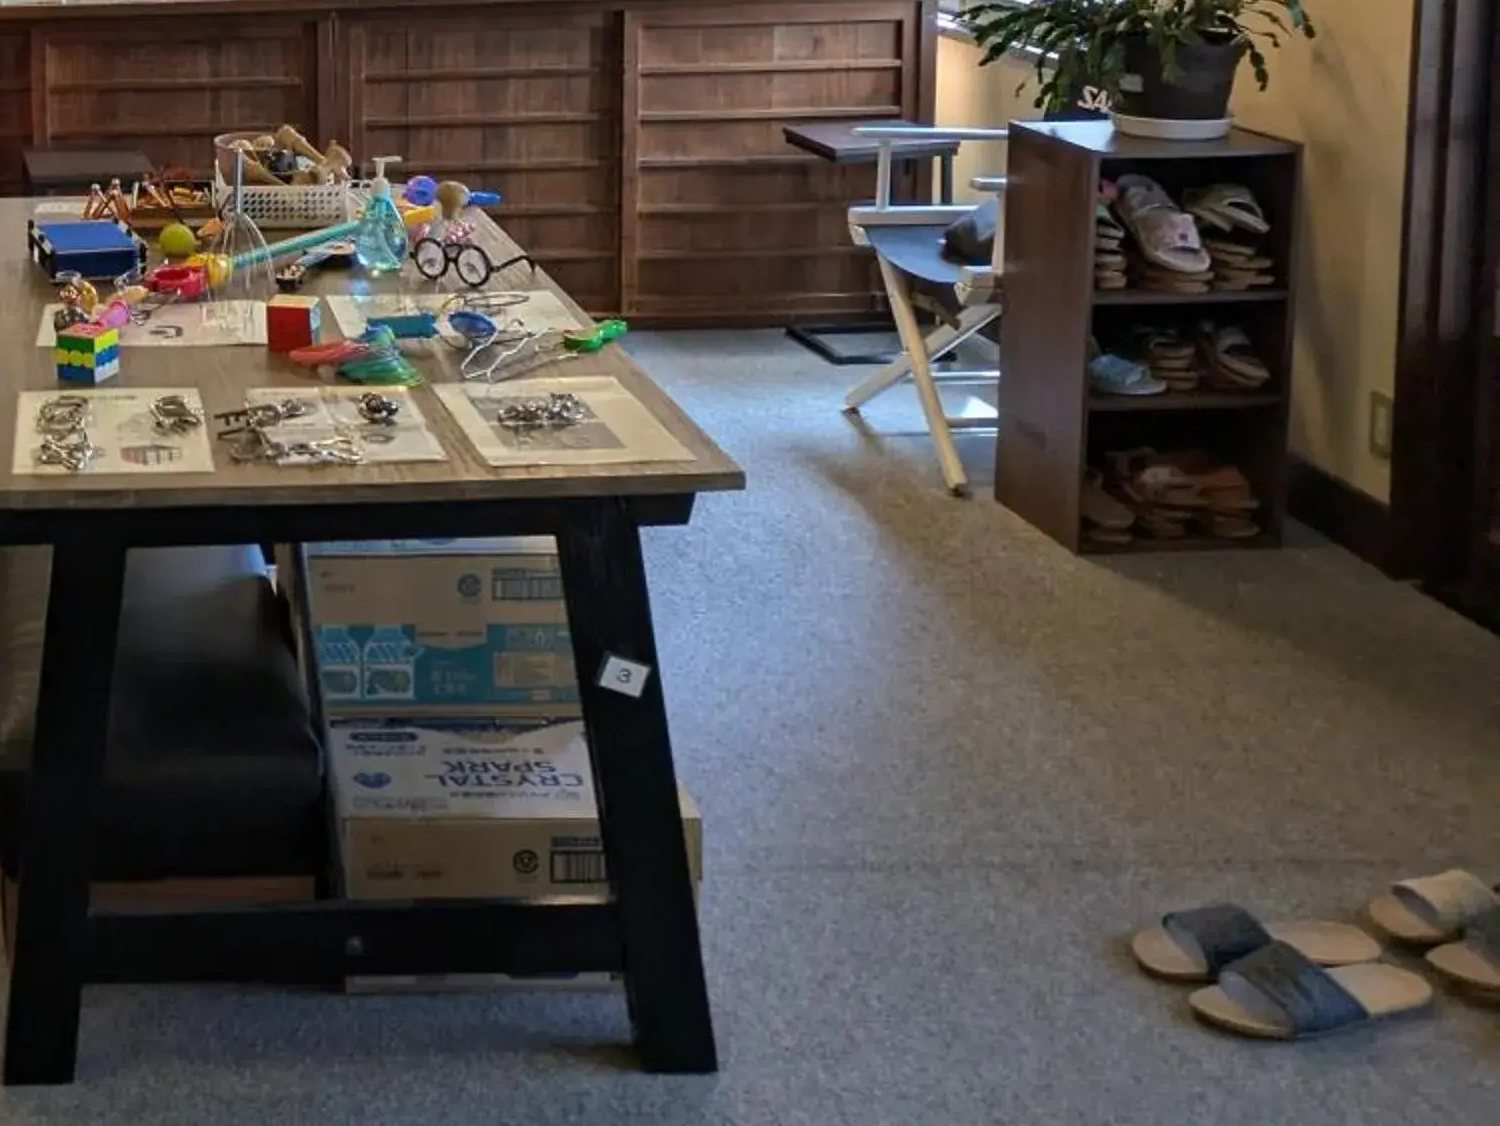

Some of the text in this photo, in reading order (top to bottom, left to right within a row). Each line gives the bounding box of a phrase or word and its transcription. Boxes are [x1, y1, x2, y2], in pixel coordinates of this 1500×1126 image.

[615, 667, 631, 684] 3
[441, 760, 557, 774] SPARK
[425, 773, 584, 787] CRYSTAL
